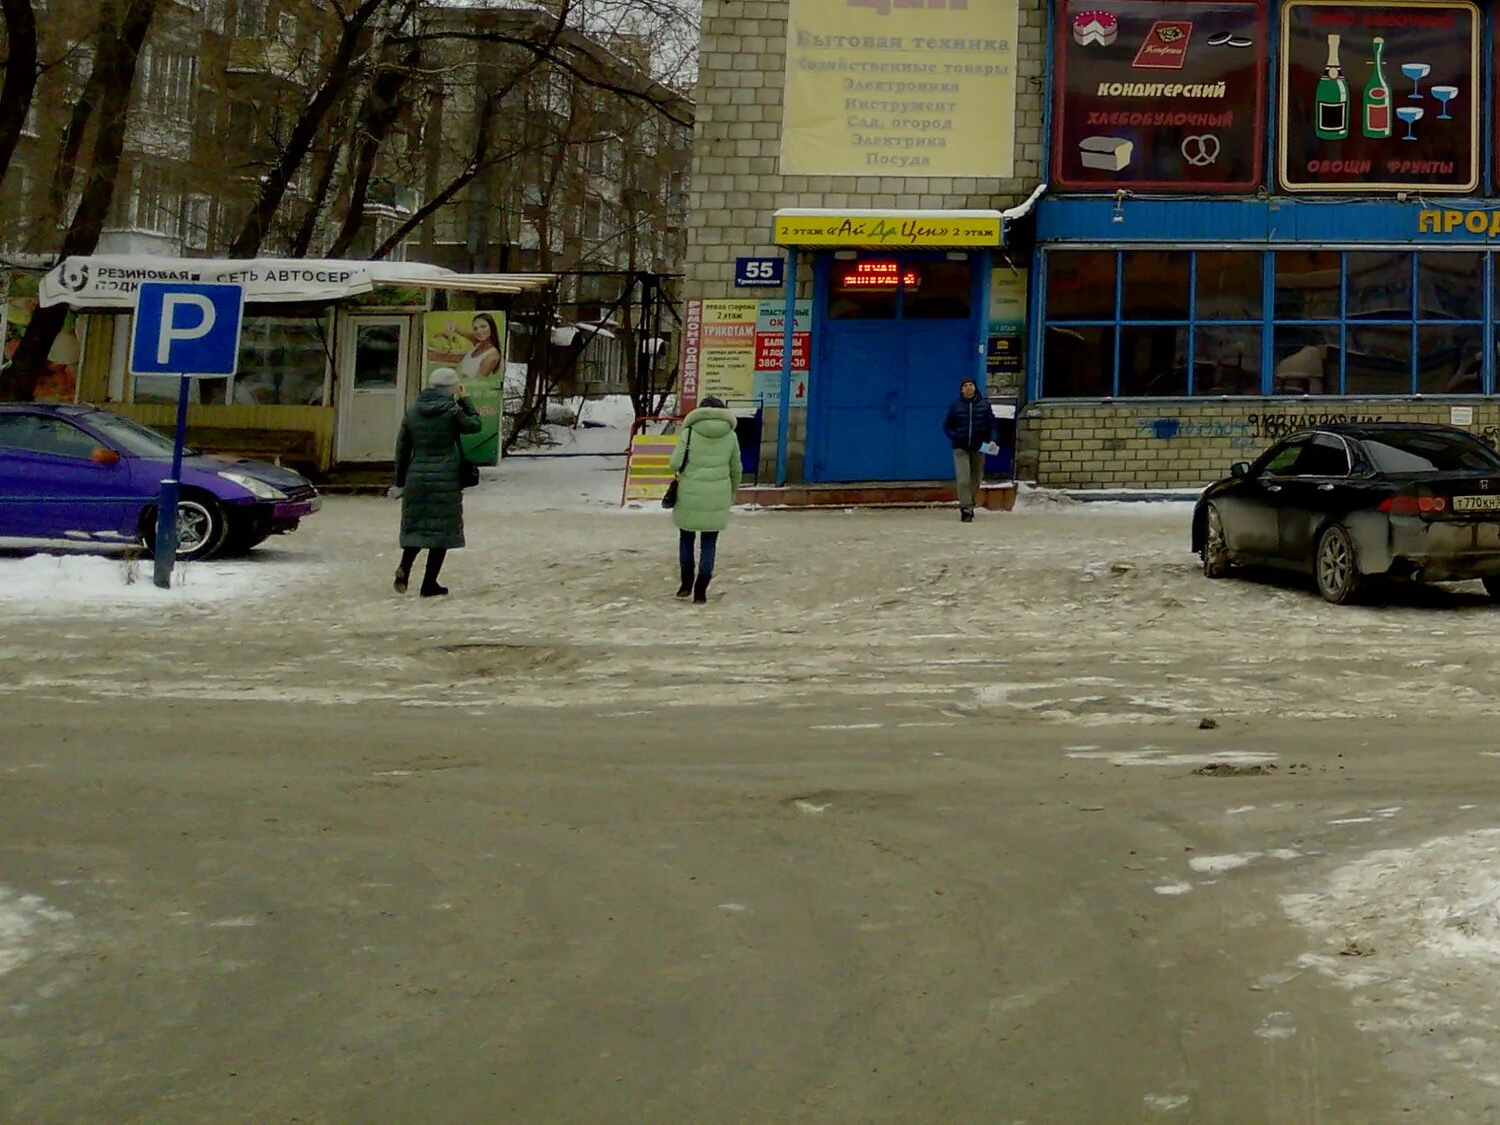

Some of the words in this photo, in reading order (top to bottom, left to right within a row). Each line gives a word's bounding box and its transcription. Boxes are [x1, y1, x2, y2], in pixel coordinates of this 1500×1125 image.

[797, 30, 904, 50] Бытовая
[910, 36, 1011, 52] техника
[842, 78, 960, 93] Электроника
[1096, 81, 1227, 98] КОНДИТЕРСКИЙ
[844, 97, 957, 114] Инструмент
[890, 119, 953, 131] огород
[1087, 110, 1234, 127] ХЛЕБОБУЛОЧНЫЙ
[852, 134, 947, 149] Электрика
[866, 152, 931, 167] Посуда
[1306, 159, 1371, 174] ОВОЩИ
[1386, 159, 1454, 174] ФРУКТЫ
[781, 227, 789, 236] 2
[792, 227, 823, 236] этаж
[952, 228, 960, 236] 2
[964, 228, 994, 237] этаж
[97, 267, 191, 282] РЕЗИНОВАЯ
[216, 266, 259, 283] СЕТЬ
[745, 261, 774, 278] 55
[686, 300, 701, 346] РЕМОНТ
[703, 325, 754, 338] ТРИКОТАЖ
[683, 347, 699, 394] ОДЕЖДЫ
